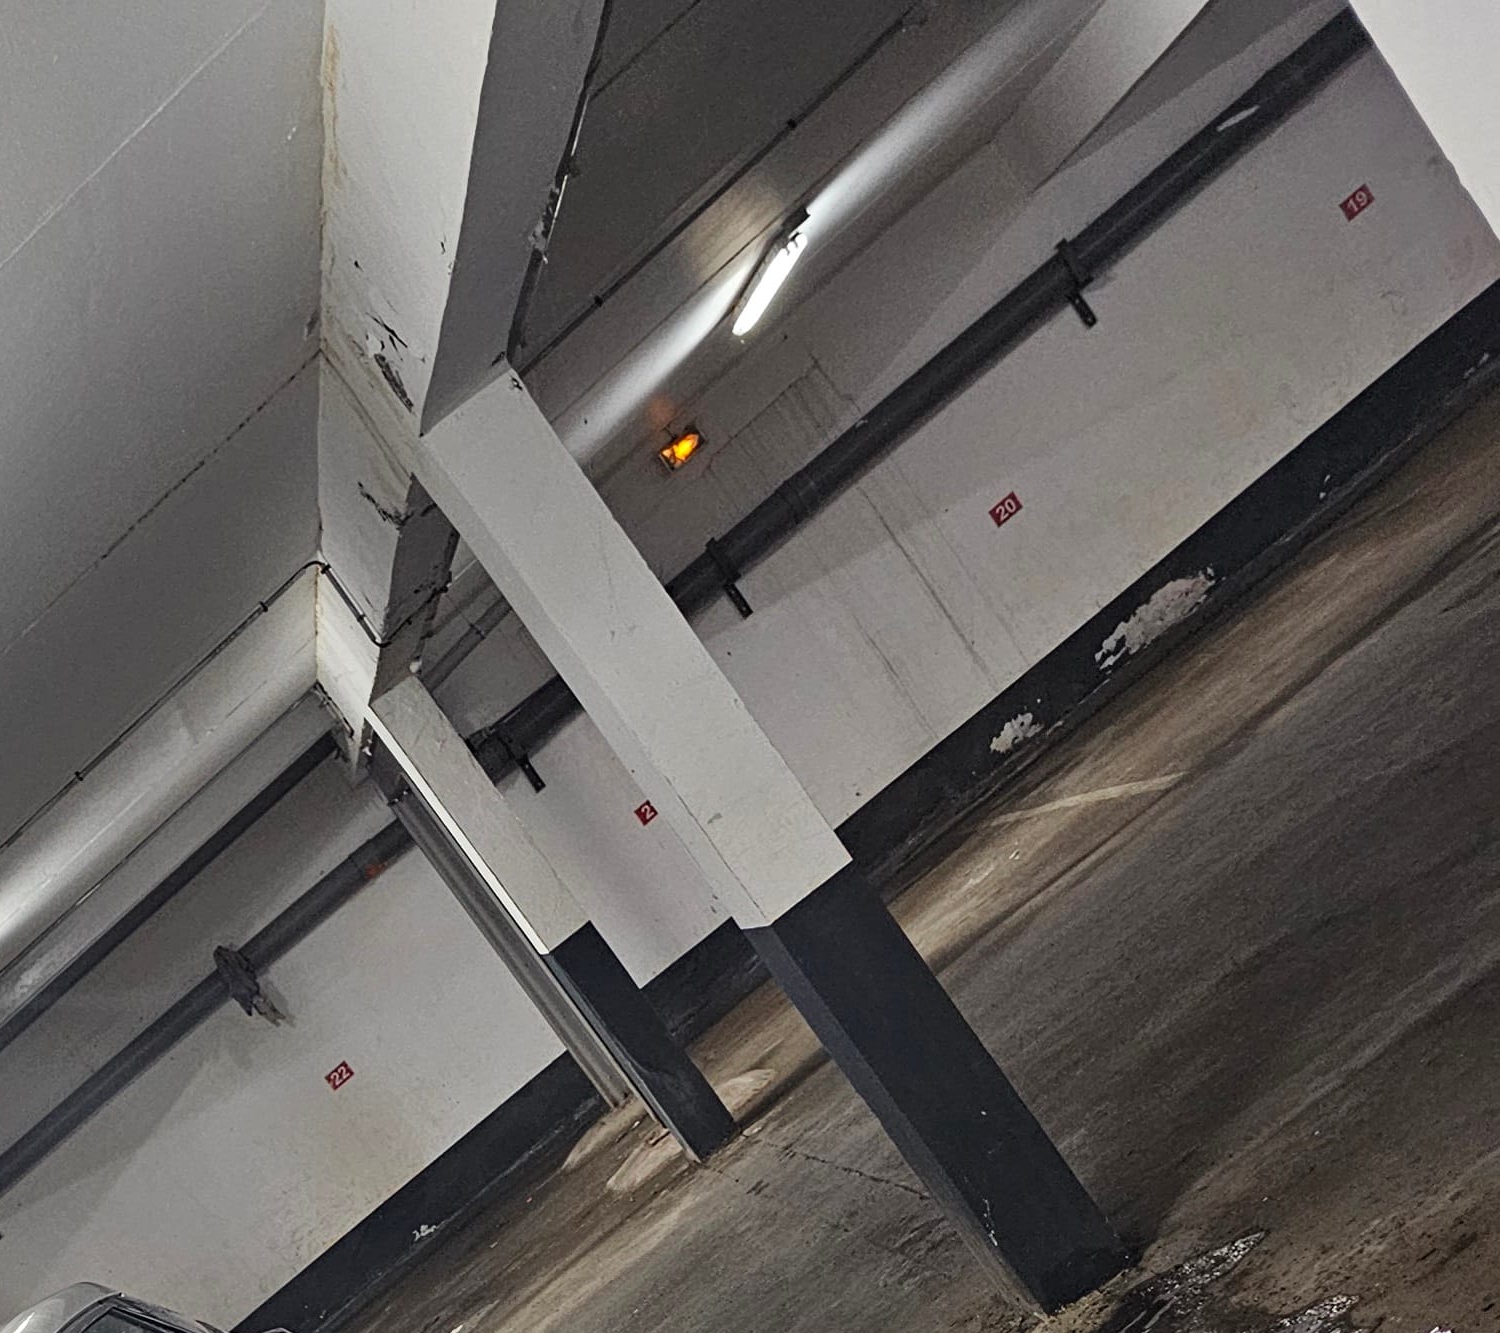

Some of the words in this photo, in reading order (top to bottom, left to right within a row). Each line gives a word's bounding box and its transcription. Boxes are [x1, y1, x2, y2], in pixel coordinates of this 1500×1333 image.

[1347, 190, 1368, 212] 19
[995, 498, 1016, 521] 20
[330, 1065, 350, 1086] 22
